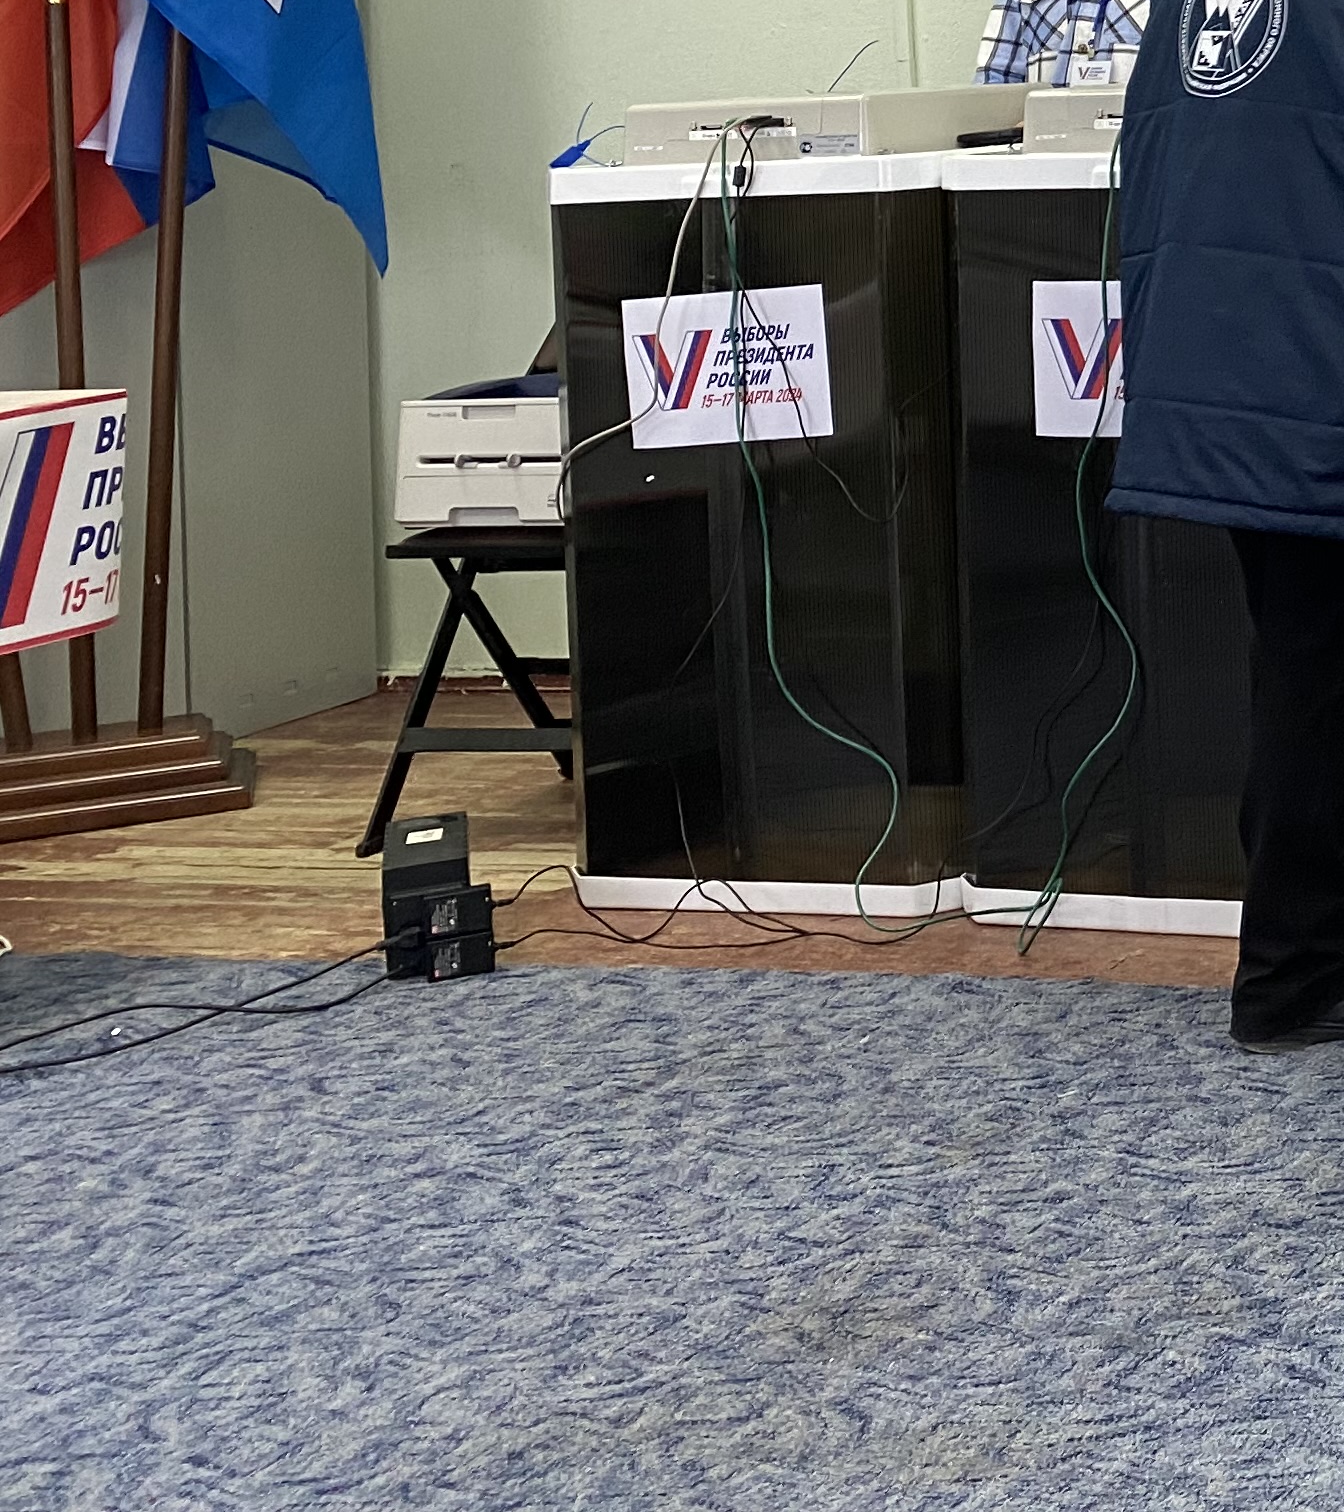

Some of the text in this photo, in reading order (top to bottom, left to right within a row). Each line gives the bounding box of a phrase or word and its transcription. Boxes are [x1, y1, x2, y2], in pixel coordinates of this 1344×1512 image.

[720, 323, 790, 344] ВЫБОРЫ
[713, 343, 814, 367] ПРЕЗИДЕНТА
[706, 369, 772, 389] РОССИИ
